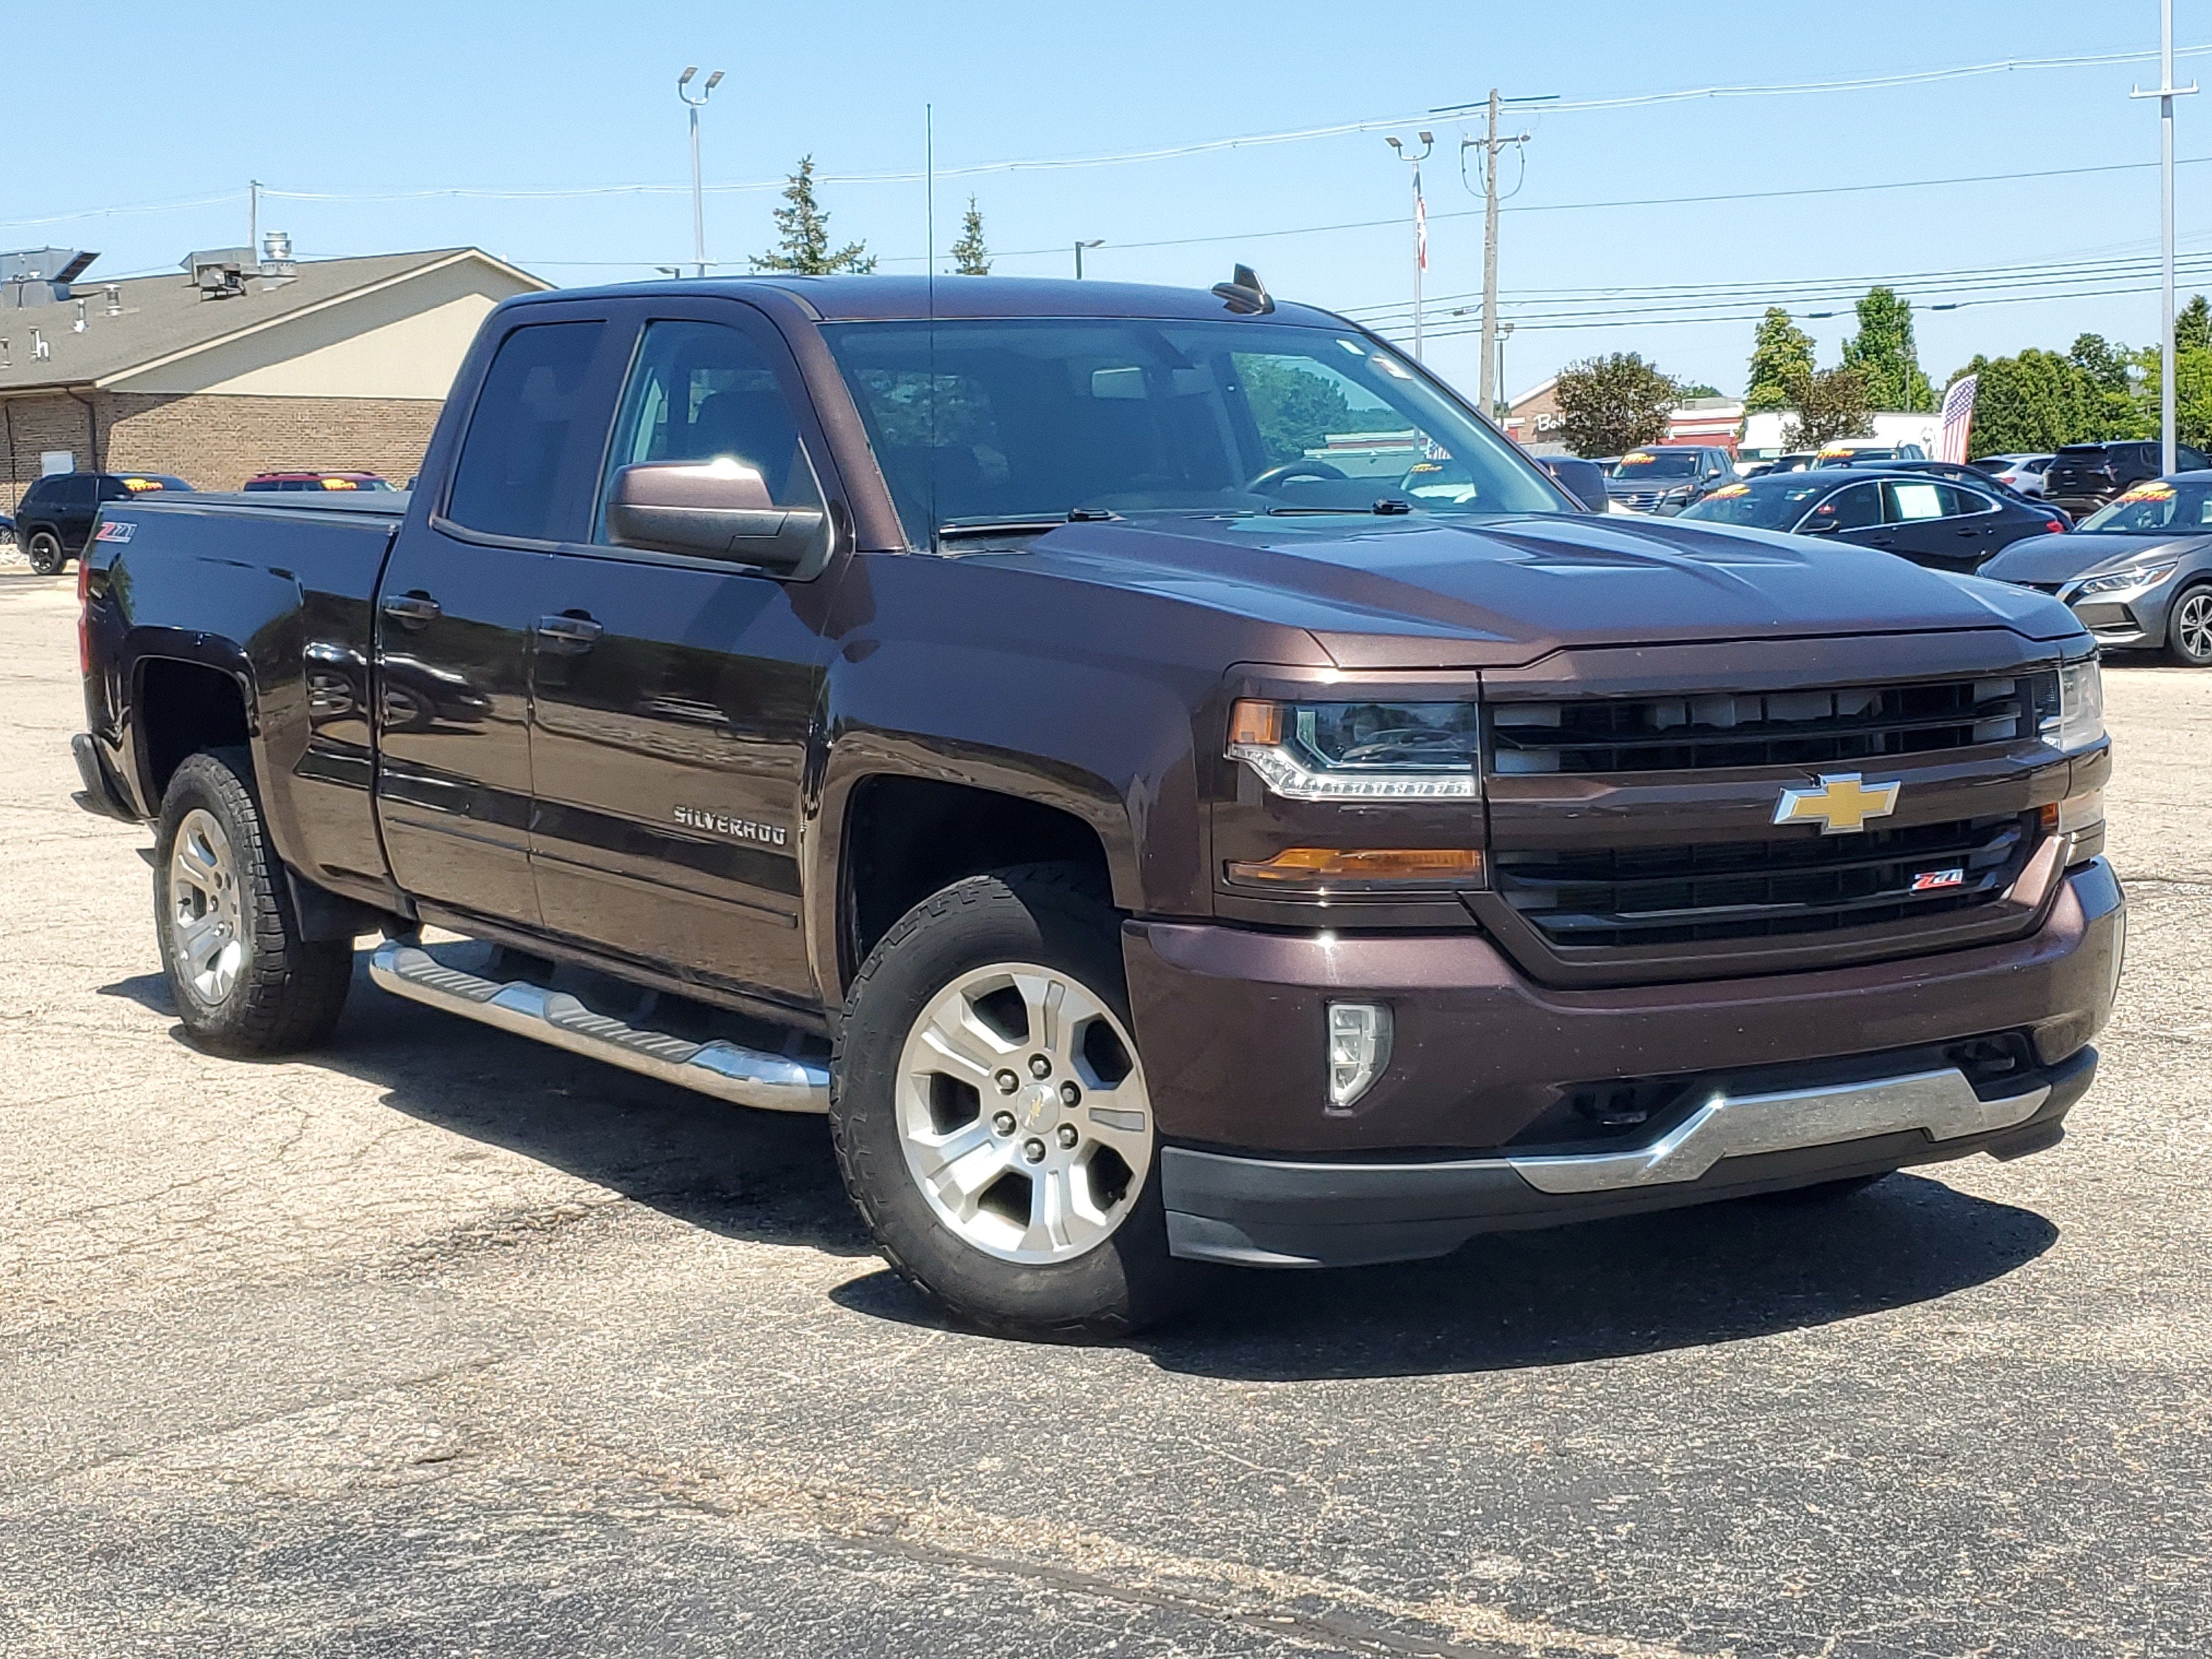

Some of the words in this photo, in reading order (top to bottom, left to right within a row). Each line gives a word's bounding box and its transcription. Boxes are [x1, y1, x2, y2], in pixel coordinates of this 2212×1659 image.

[95, 521, 138, 543] Z71
[674, 805, 786, 845] SILVERADO
[1911, 868, 1963, 889] Z71
